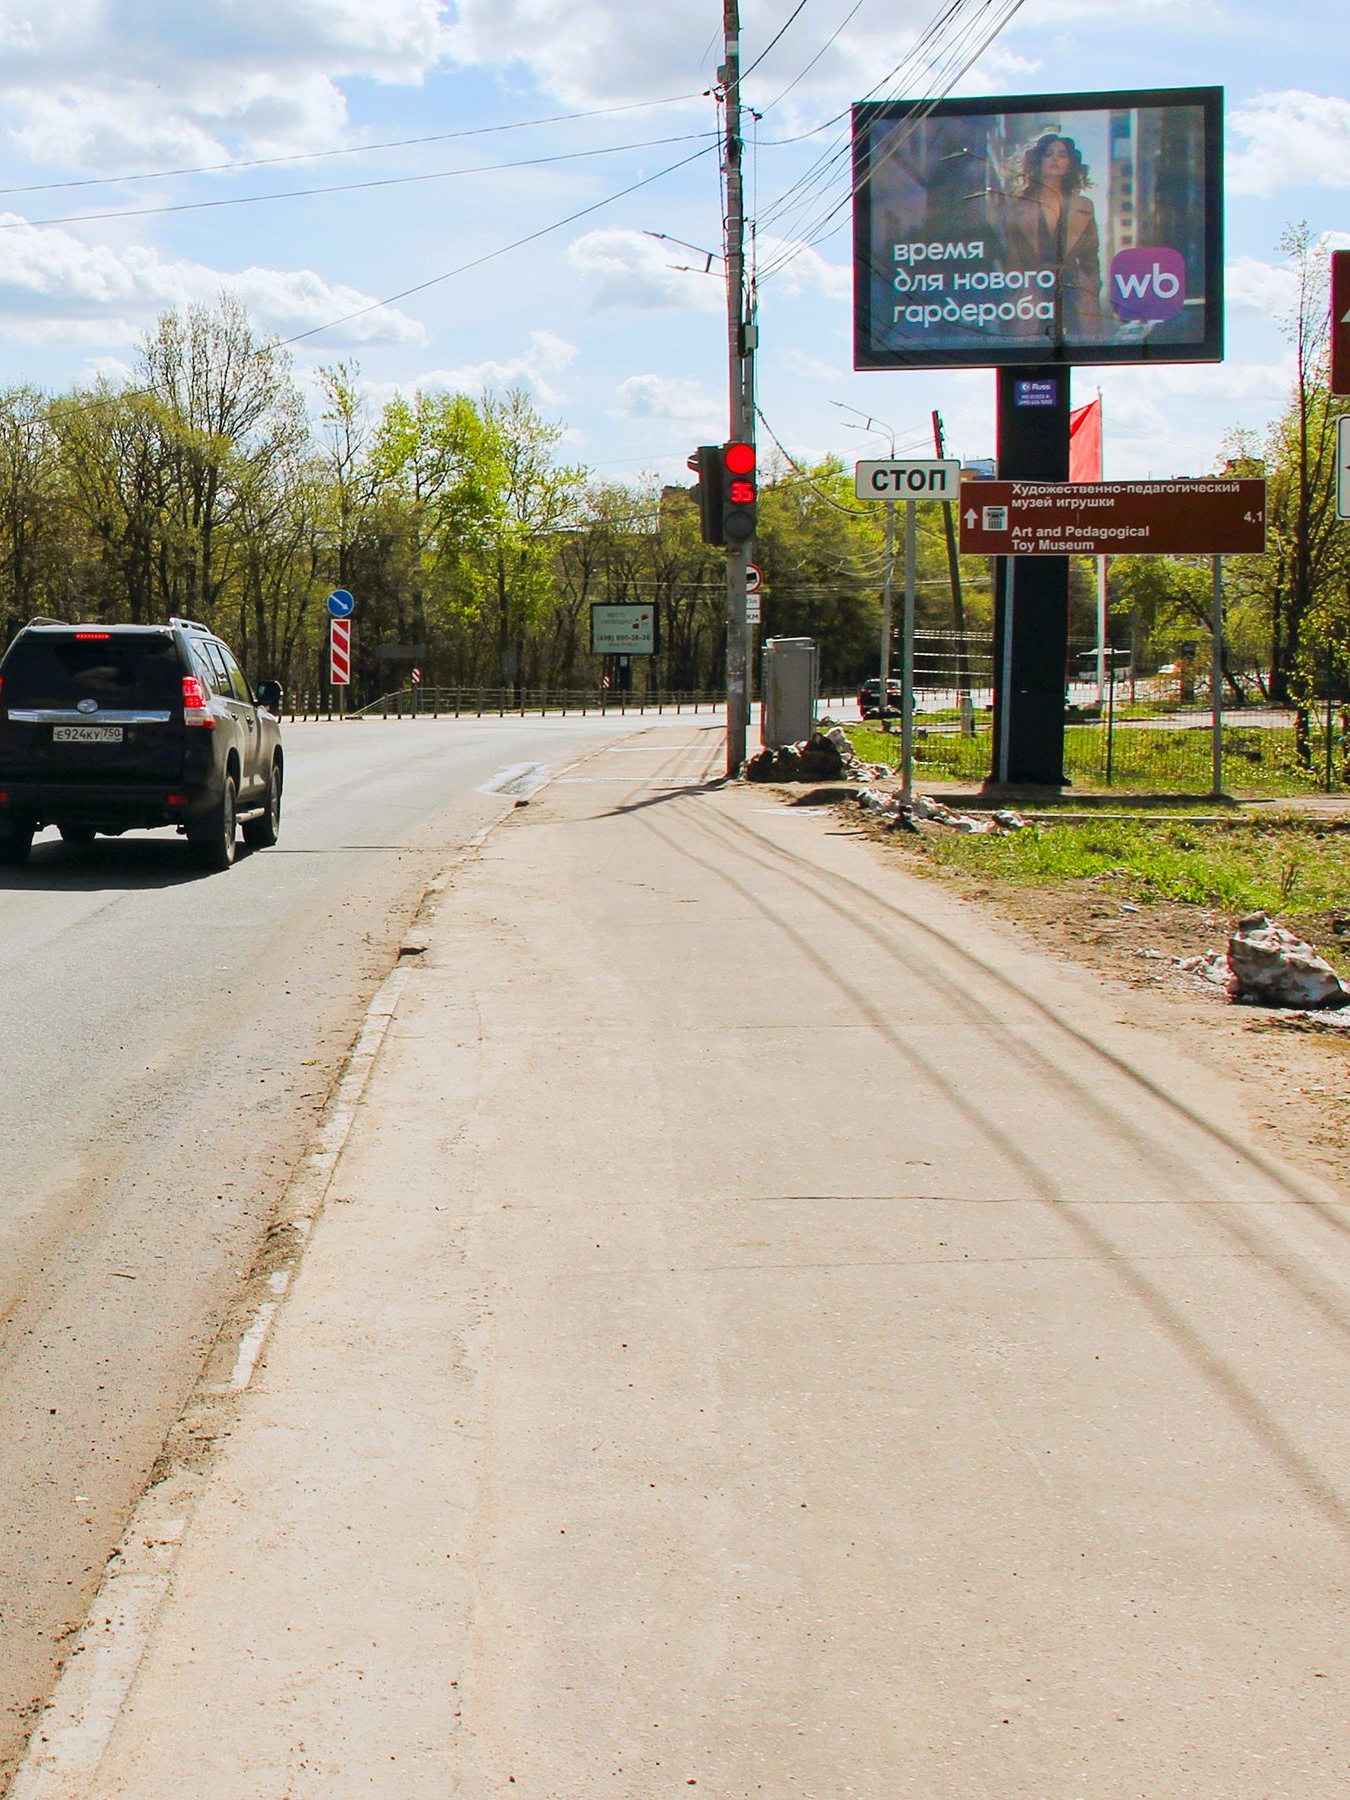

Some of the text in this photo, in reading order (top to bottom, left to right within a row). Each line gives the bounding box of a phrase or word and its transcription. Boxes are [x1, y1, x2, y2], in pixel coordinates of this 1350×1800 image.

[893, 241, 984, 266] время
[893, 268, 1056, 292] для нового
[1114, 263, 1179, 299] wb
[893, 295, 1055, 328] гардероба
[871, 469, 947, 491] СТОП
[1012, 482, 1240, 497] Художественно-педагогический
[1011, 497, 1115, 510] музей игрушки
[1244, 511, 1263, 523] 4,1
[1011, 525, 1150, 539] Art and Pedagogical
[1012, 540, 1094, 552] Toy Museum
